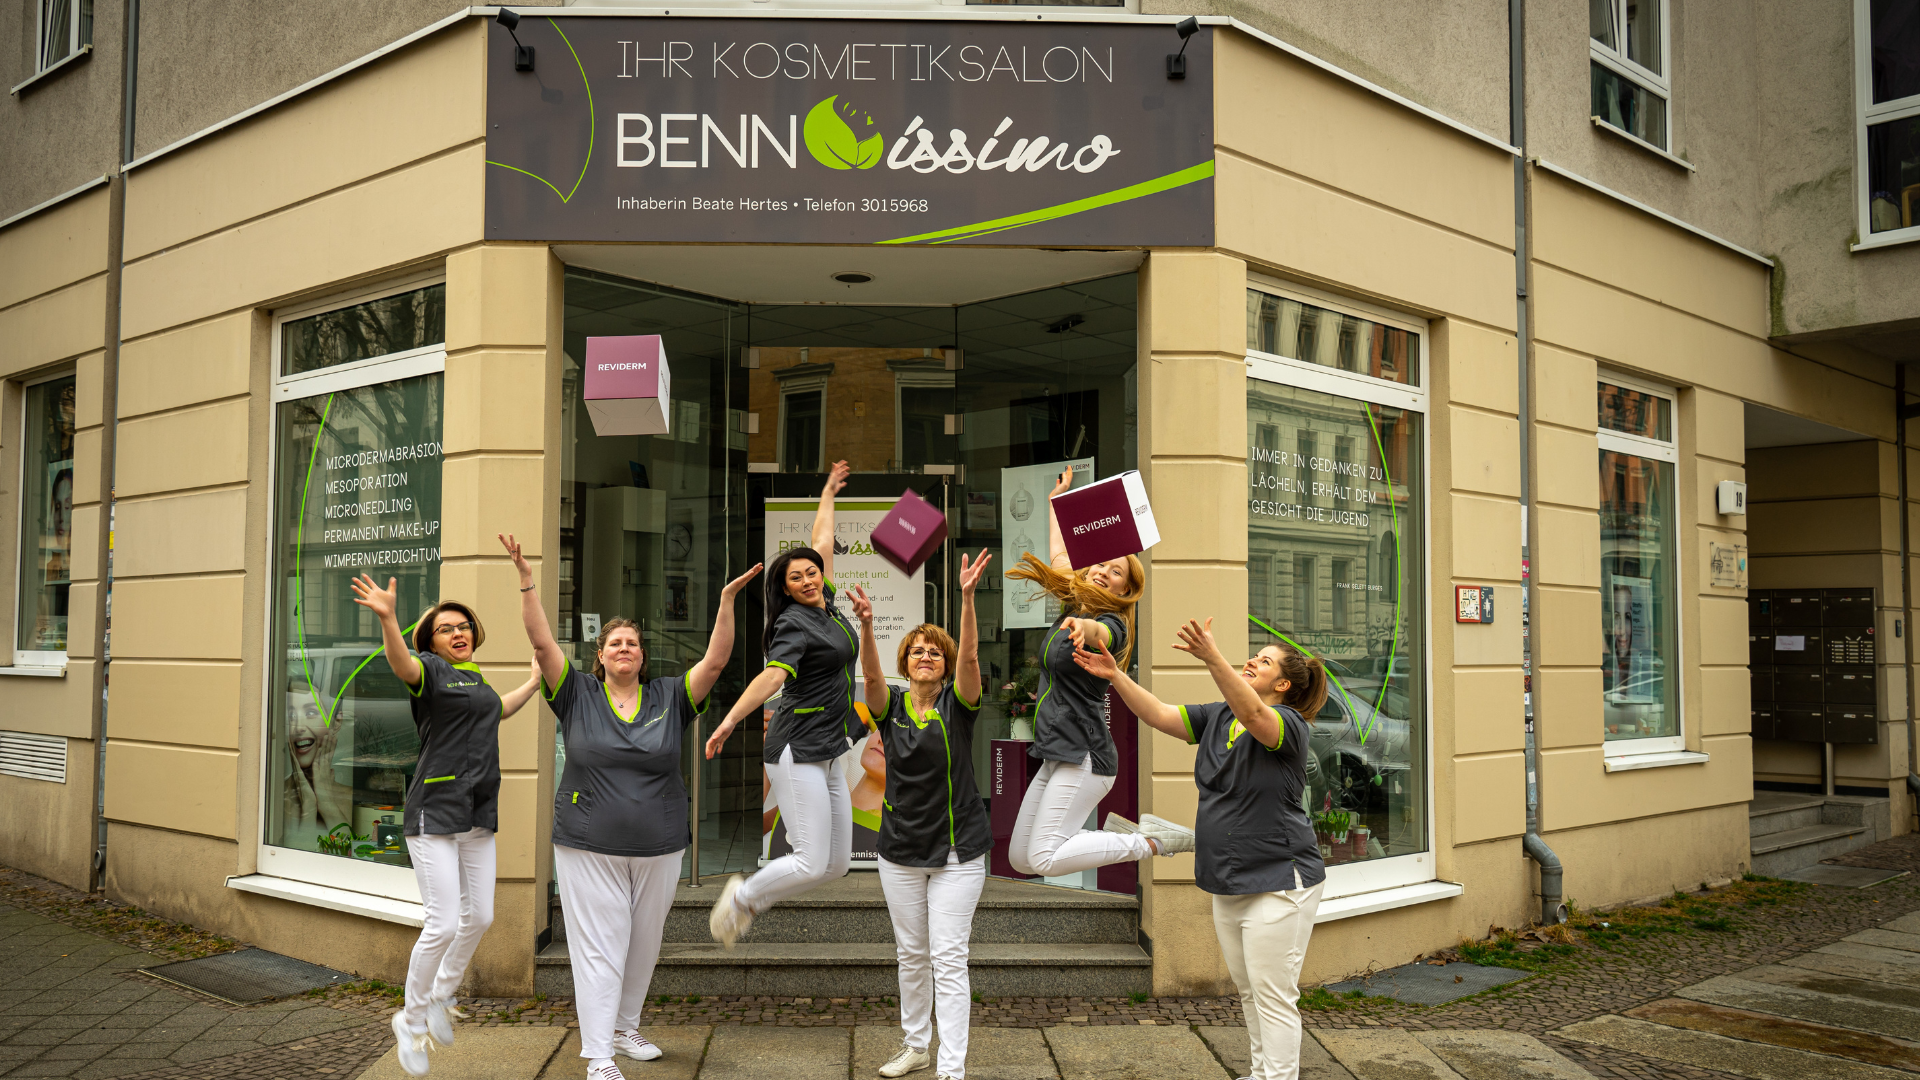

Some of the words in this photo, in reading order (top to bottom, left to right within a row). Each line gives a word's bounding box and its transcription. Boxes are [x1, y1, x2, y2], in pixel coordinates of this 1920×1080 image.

[617, 41, 694, 78] IHR
[713, 41, 1113, 83] KOSMETIKSALON
[617, 196, 687, 211] Inhaberin
[692, 197, 735, 211] Beate
[739, 197, 788, 212] Hertes
[804, 198, 855, 212] Telefon
[860, 198, 929, 213] 3015968
[598, 362, 647, 372] REVIDERM
[326, 441, 444, 471] MICRODERMABRASION
[1251, 446, 1288, 466] IMMER
[1293, 453, 1305, 468] IN
[1309, 457, 1366, 478] GEDANKEN
[1370, 467, 1383, 481] ZU
[325, 472, 408, 495] MESOPORATION
[1251, 472, 1308, 496] LÄCHELN,
[1312, 482, 1352, 500] ERHÄLT
[1355, 488, 1377, 504] DEM
[325, 497, 412, 519] MICRONEEDLING
[1735, 491, 1743, 508] 19
[1251, 499, 1302, 518] GESICHT
[1306, 506, 1325, 522] DIE
[1329, 510, 1372, 528] JUGEND.
[324, 525, 386, 544] PERMANENT
[389, 520, 440, 539] MAKE-UP
[779, 522, 799, 533] IHR
[1072, 514, 1122, 536] REVIDERM
[324, 546, 441, 568] WIMPERNVERDICHTUN
[833, 570, 868, 579] ruchtet
[871, 570, 889, 579] und
[849, 581, 873, 591] ght.
